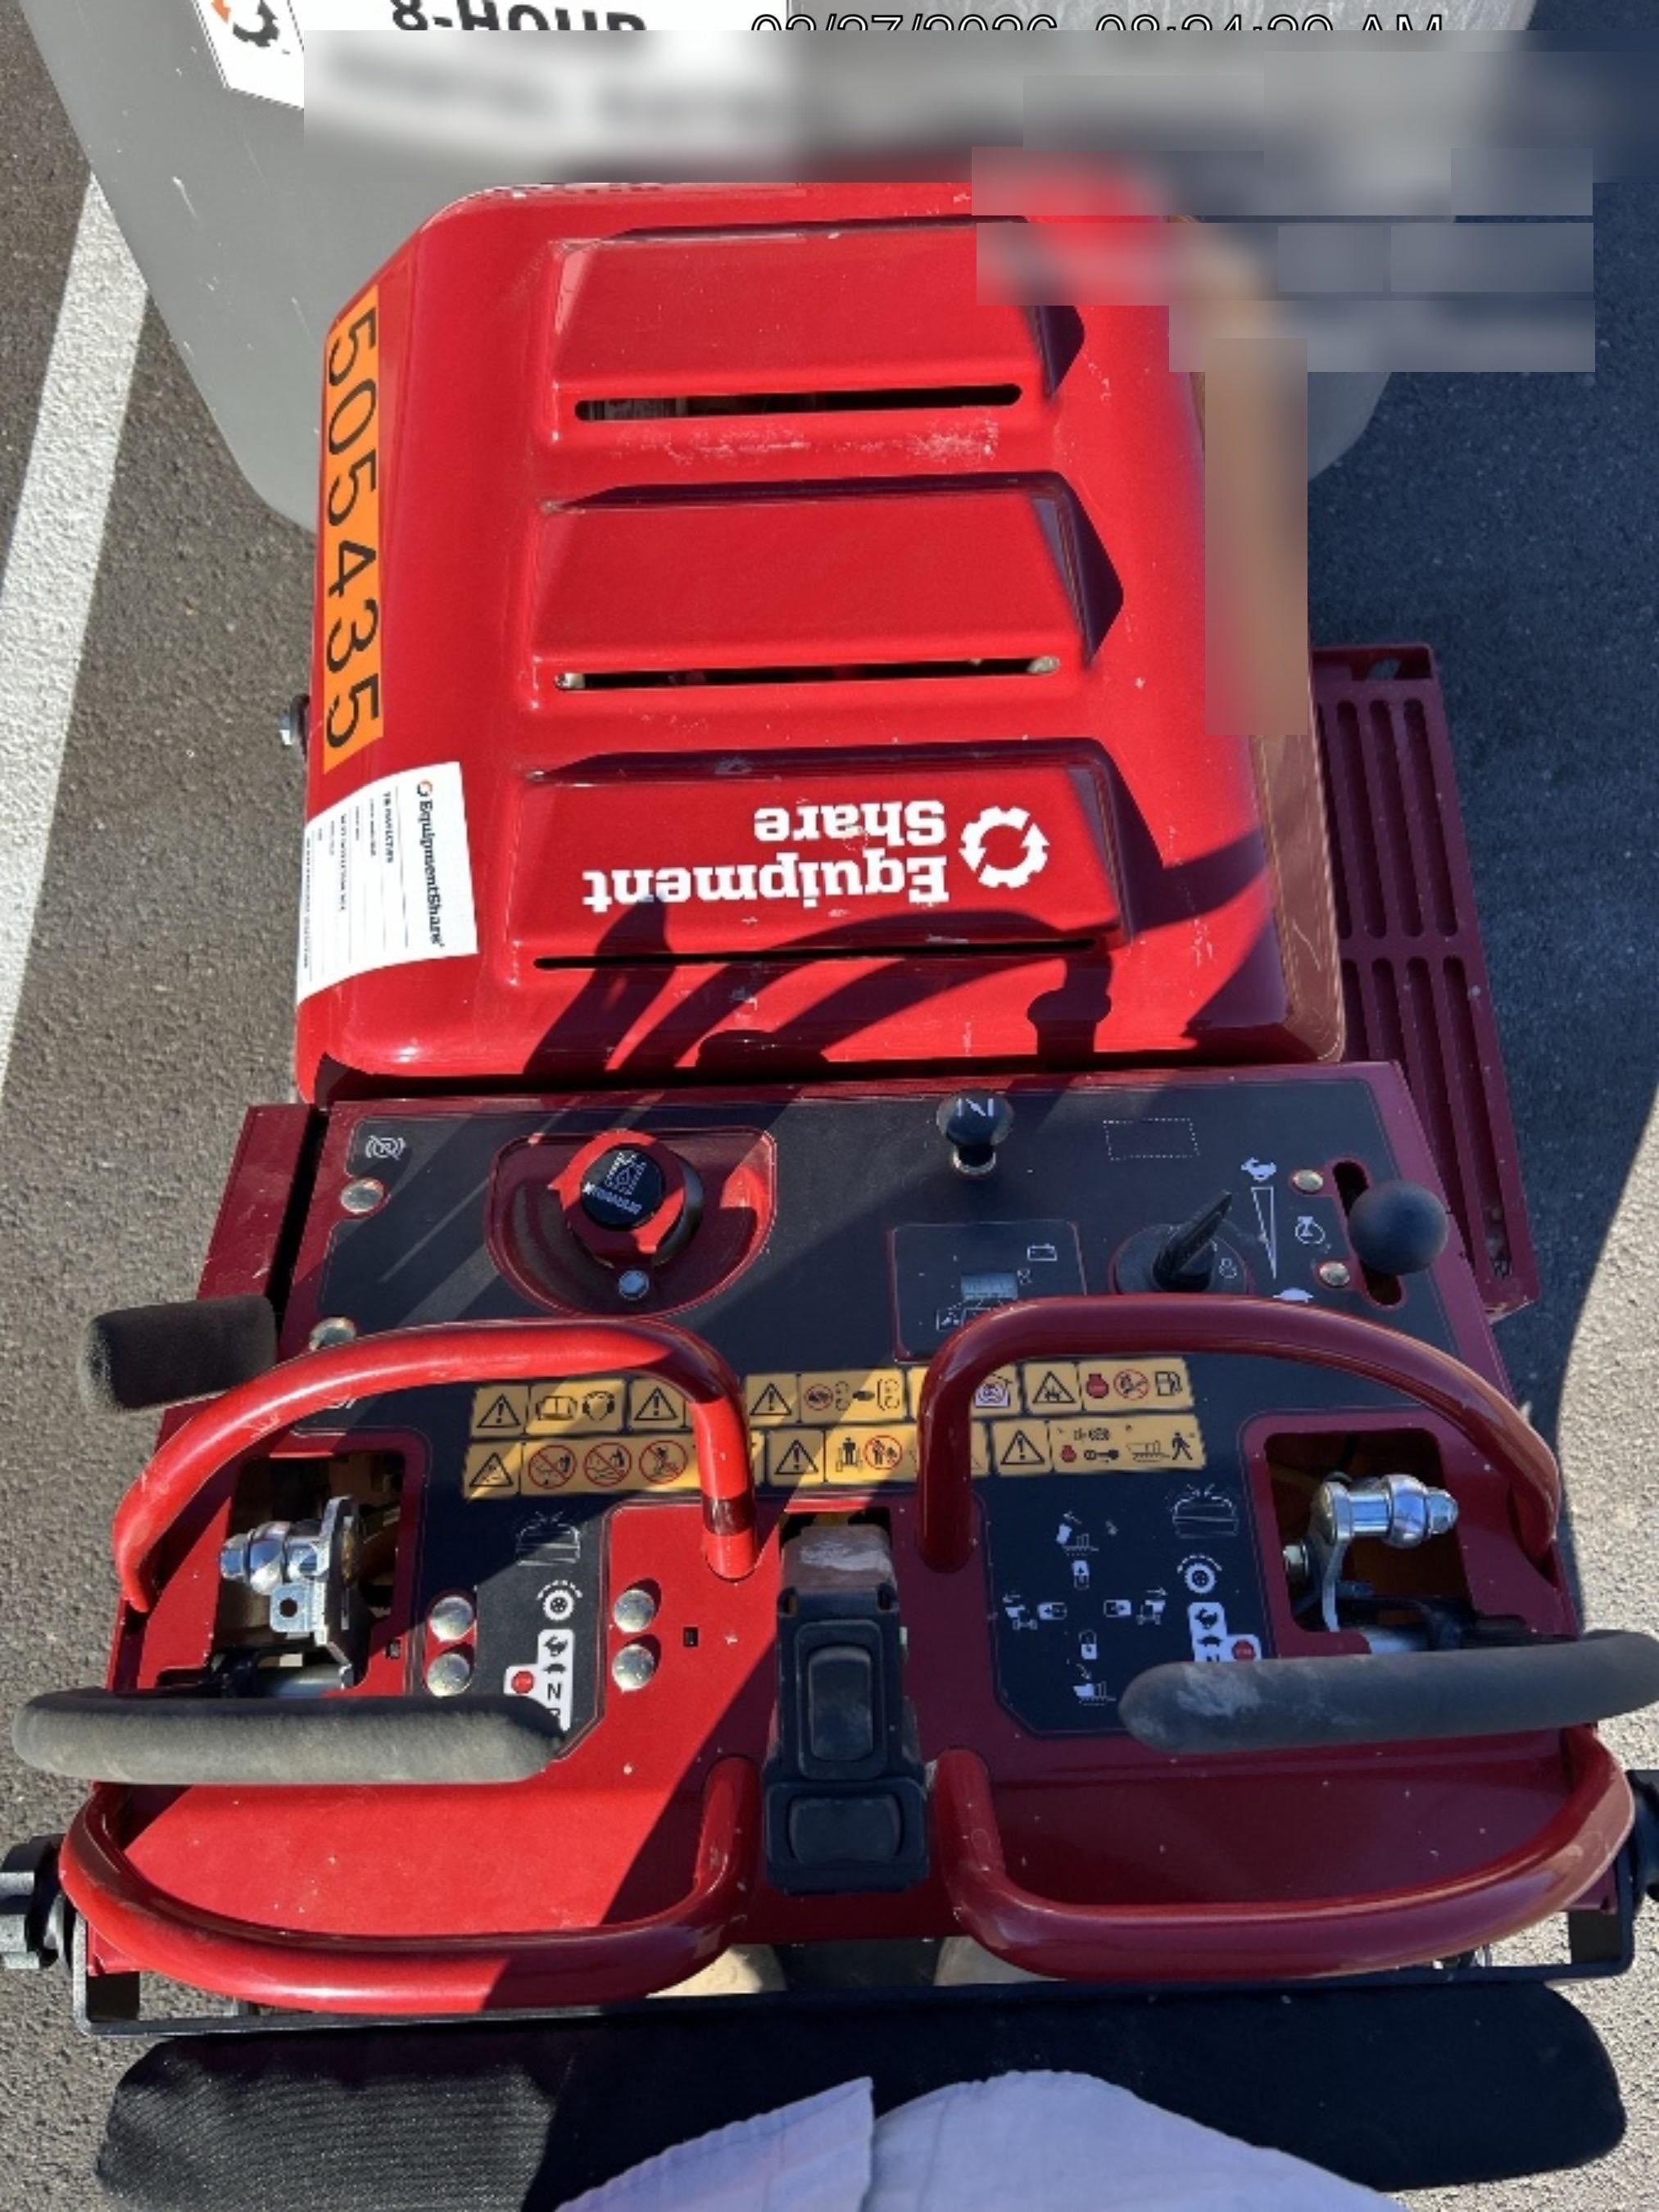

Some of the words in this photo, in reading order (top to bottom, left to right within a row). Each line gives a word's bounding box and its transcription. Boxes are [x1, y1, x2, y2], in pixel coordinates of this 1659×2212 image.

[328, 308, 378, 748] 505435
[754, 800, 947, 846] Share
[419, 800, 443, 945] EquipmentShare
[582, 848, 950, 913] Equipment
[547, 1682, 562, 1700] N
